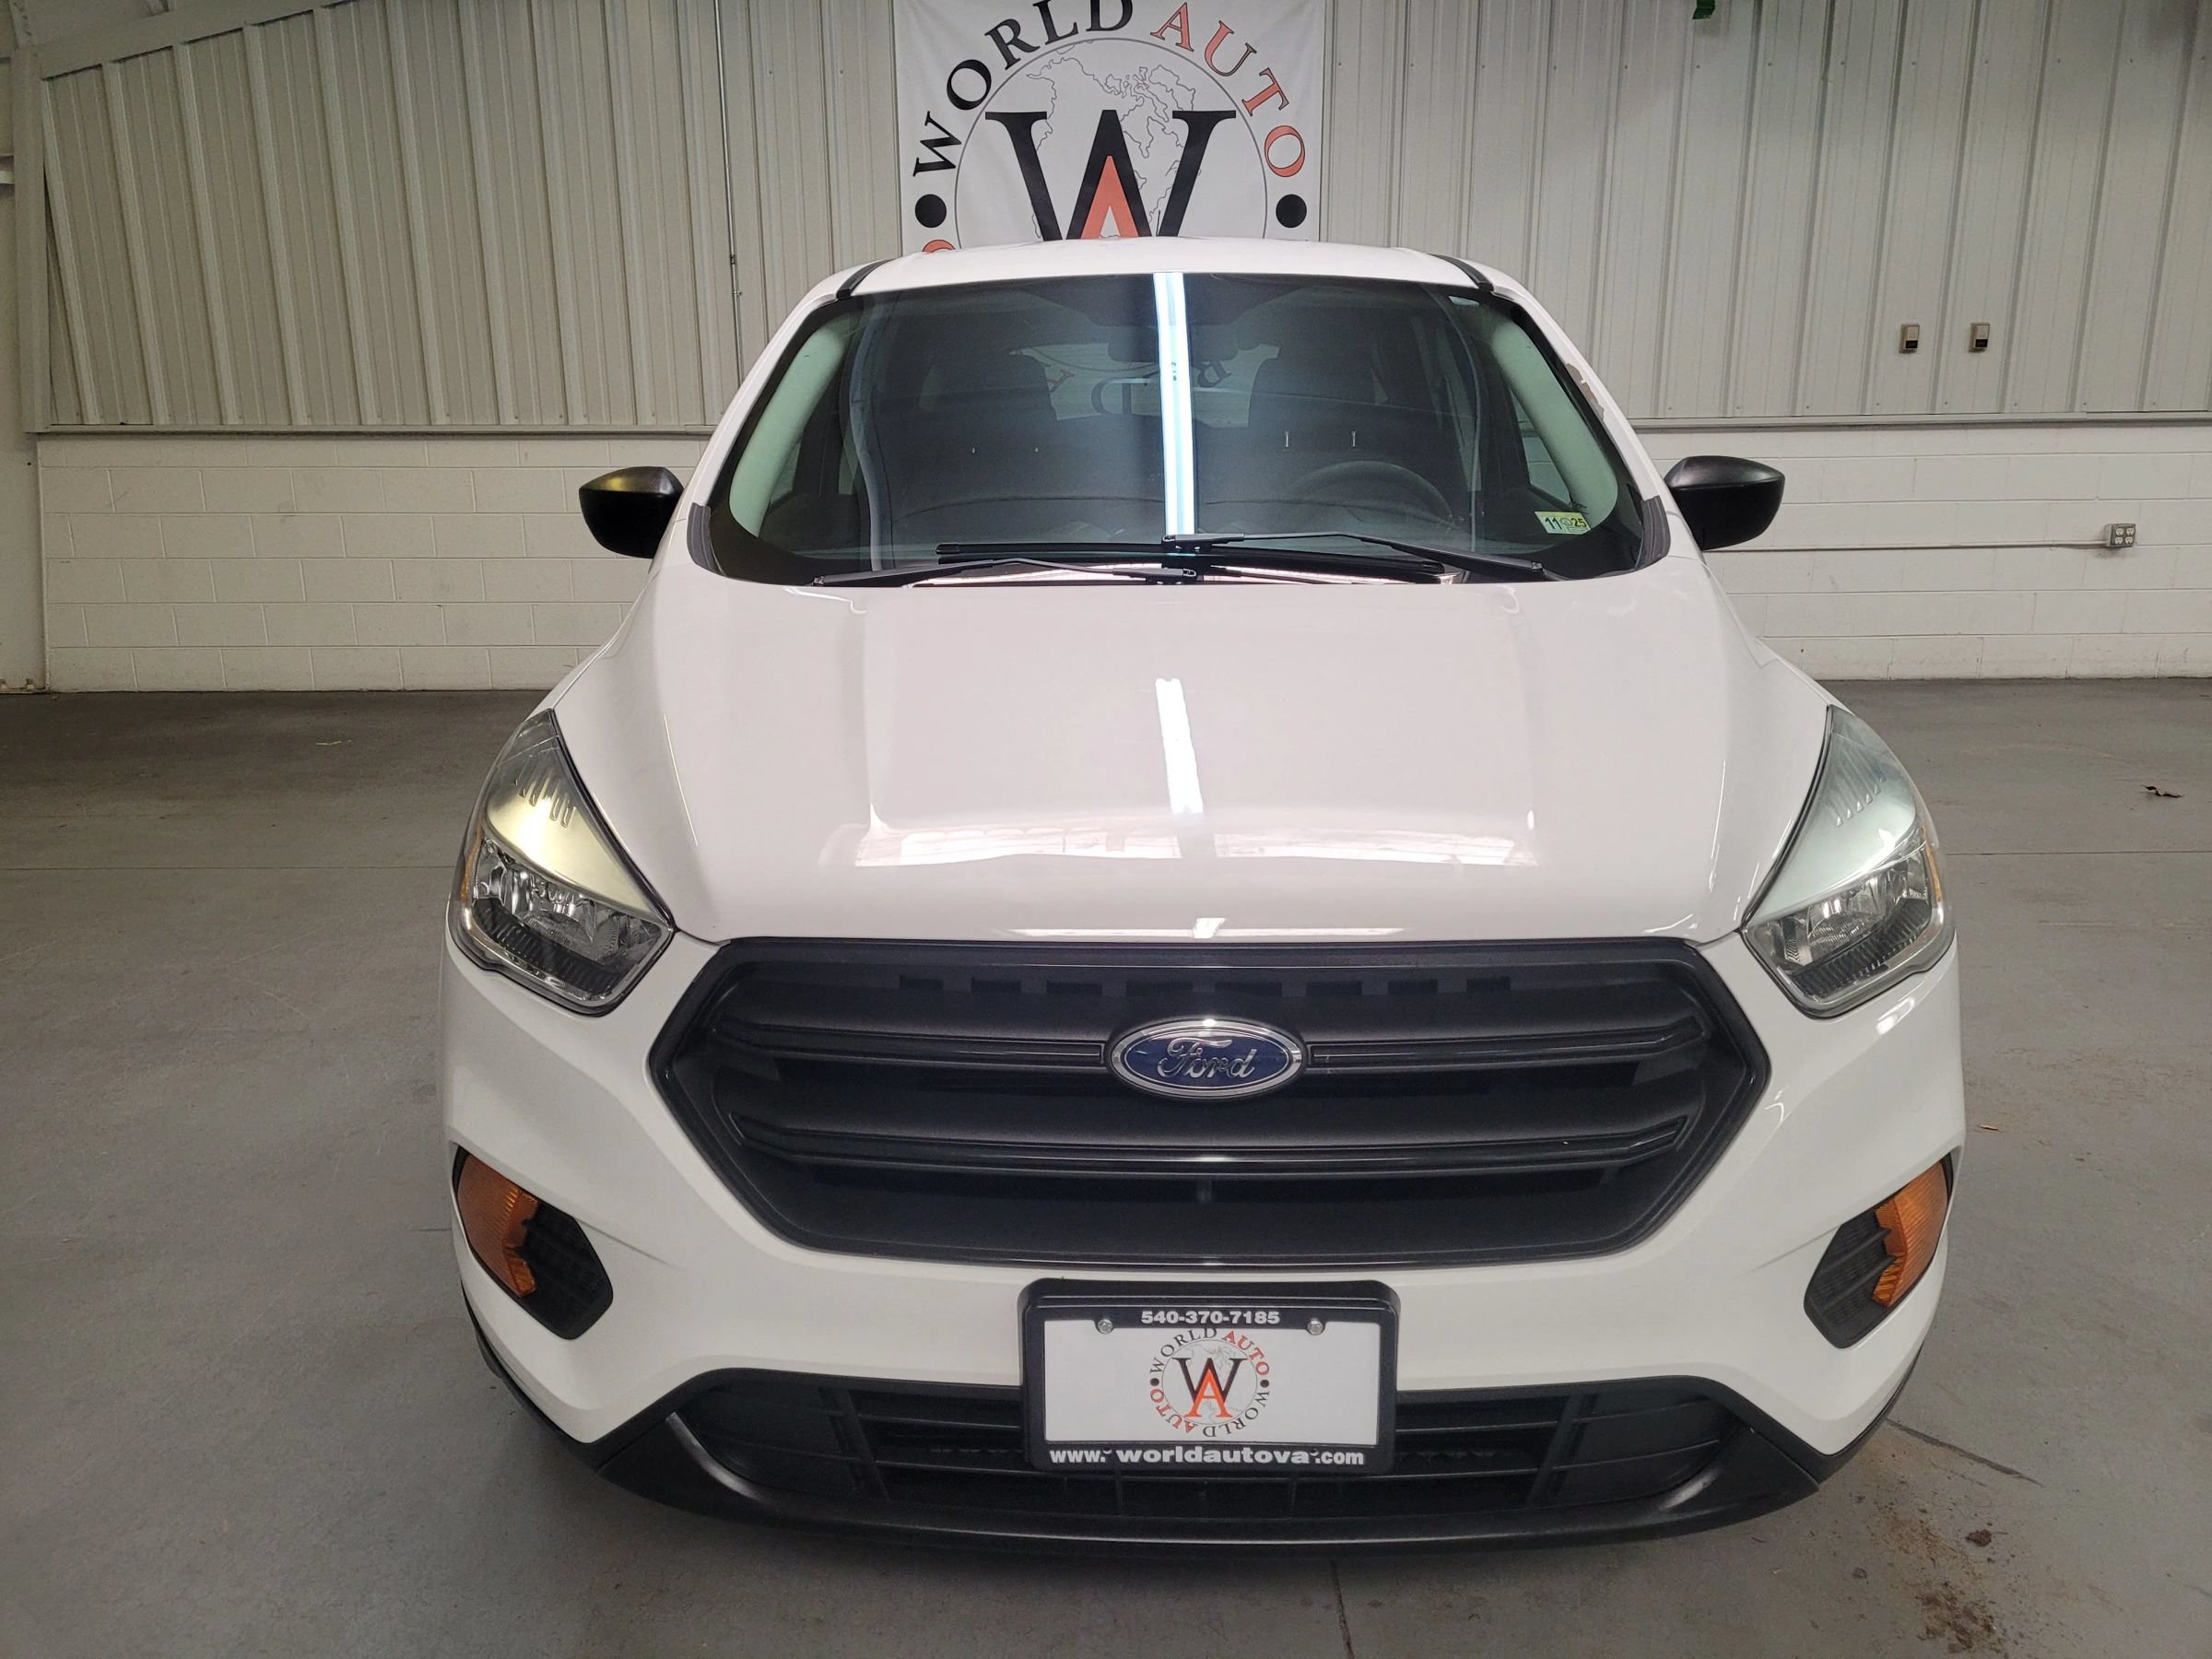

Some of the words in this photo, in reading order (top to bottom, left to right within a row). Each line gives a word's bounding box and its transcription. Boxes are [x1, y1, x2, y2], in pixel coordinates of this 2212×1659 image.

[913, 0, 1133, 177] WORLD
[1150, 2, 1306, 178] AUTO
[1545, 517, 1562, 531] 11
[1571, 517, 1587, 528] 25
[1157, 1037, 1258, 1078] Ford
[1141, 1311, 1280, 1324] 540-370-7185
[1149, 1327, 1218, 1374] WORLD
[1221, 1330, 1270, 1376] AUTO
[1149, 1388, 1198, 1434] AUTO
[1202, 1391, 1270, 1438] WORLD
